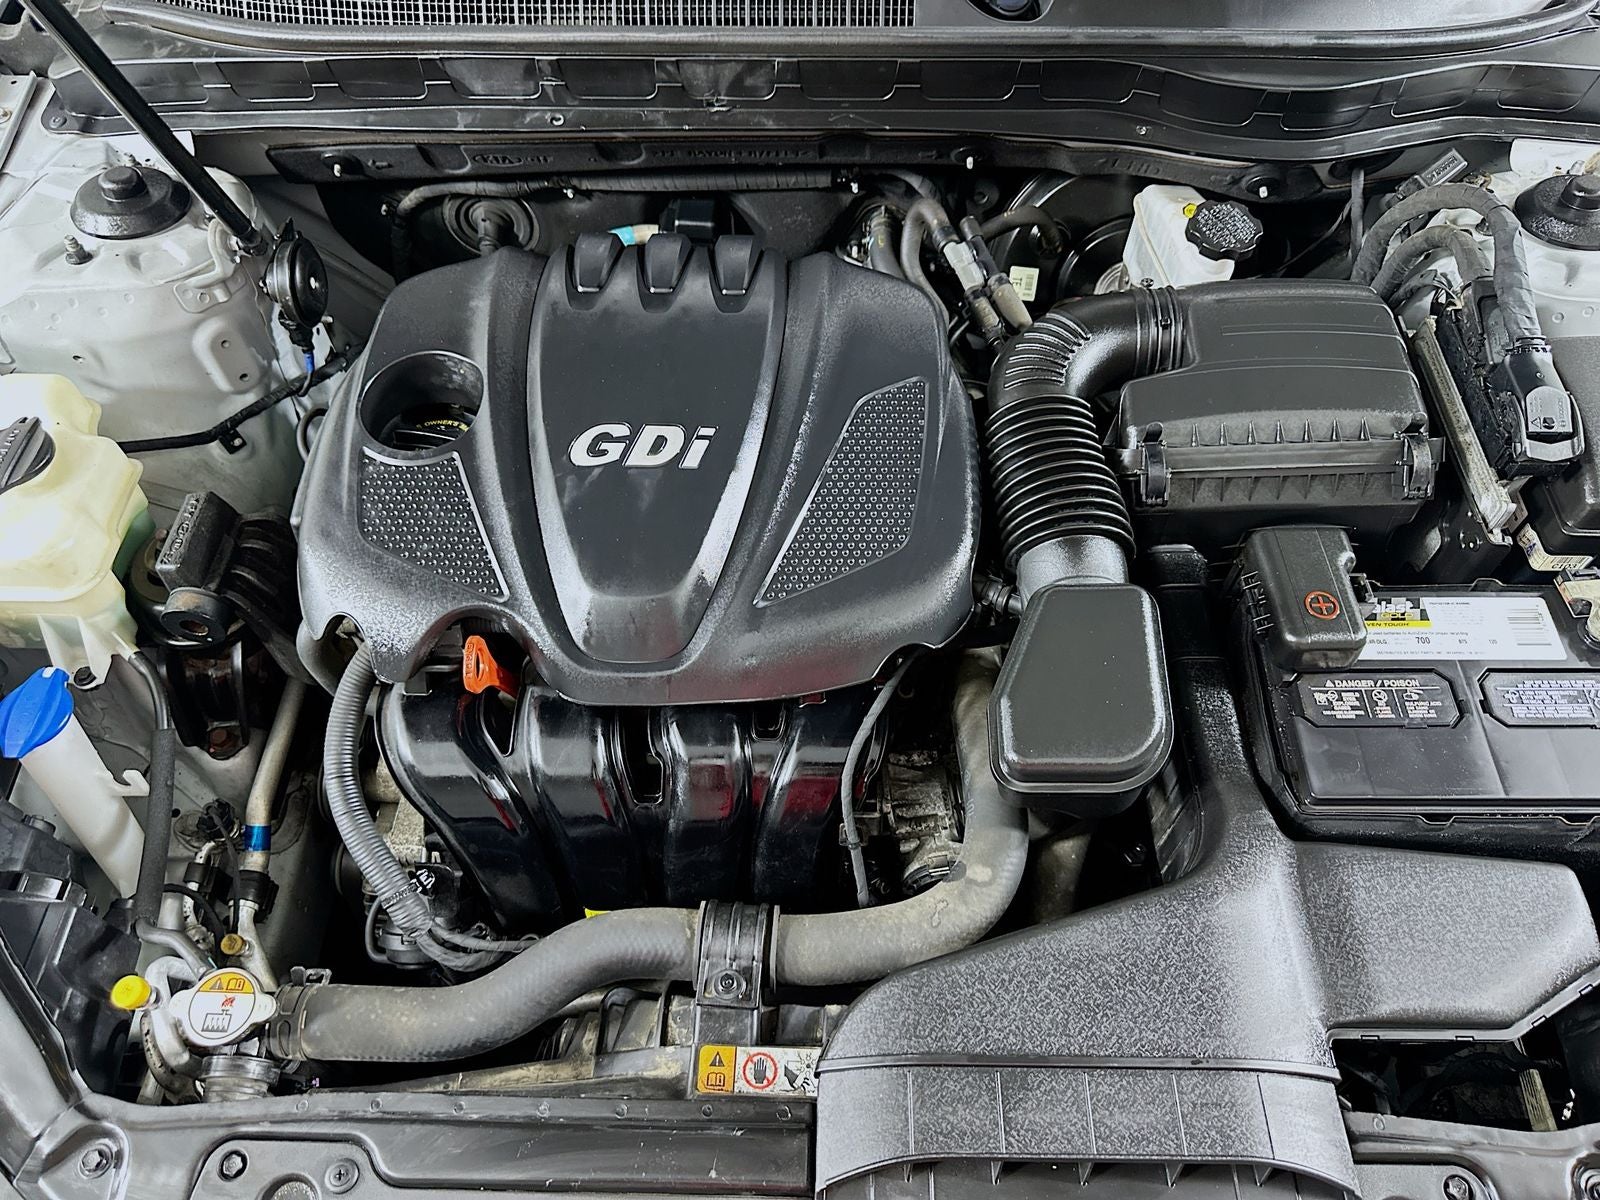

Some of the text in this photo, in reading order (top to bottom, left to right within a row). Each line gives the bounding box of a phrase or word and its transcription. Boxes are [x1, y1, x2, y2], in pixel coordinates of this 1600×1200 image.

[568, 422, 719, 469] GDi
[1372, 601, 1413, 614] alast
[1415, 636, 1431, 644] 700
